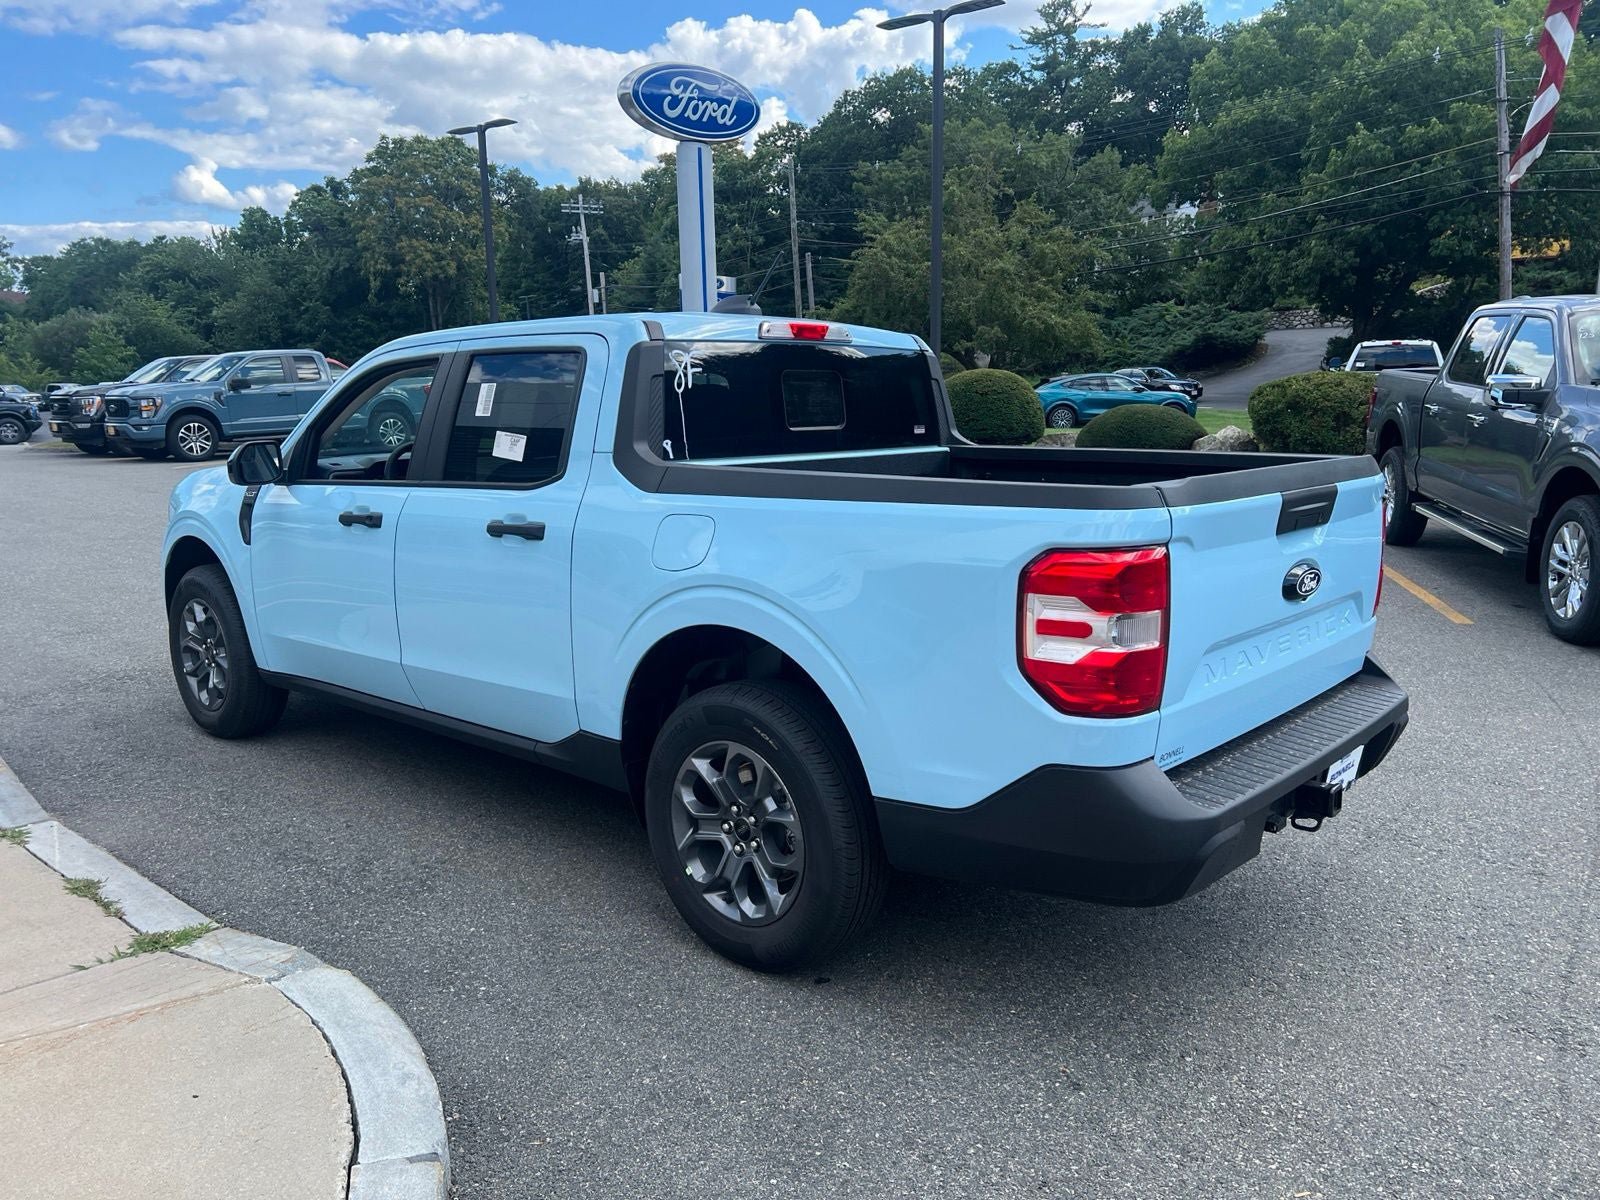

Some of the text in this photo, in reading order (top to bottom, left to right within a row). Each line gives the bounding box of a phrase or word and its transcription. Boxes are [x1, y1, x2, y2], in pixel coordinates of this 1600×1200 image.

[663, 75, 737, 126] Ford
[1301, 573, 1319, 592] Ford
[1204, 609, 1351, 687] MAVERICK
